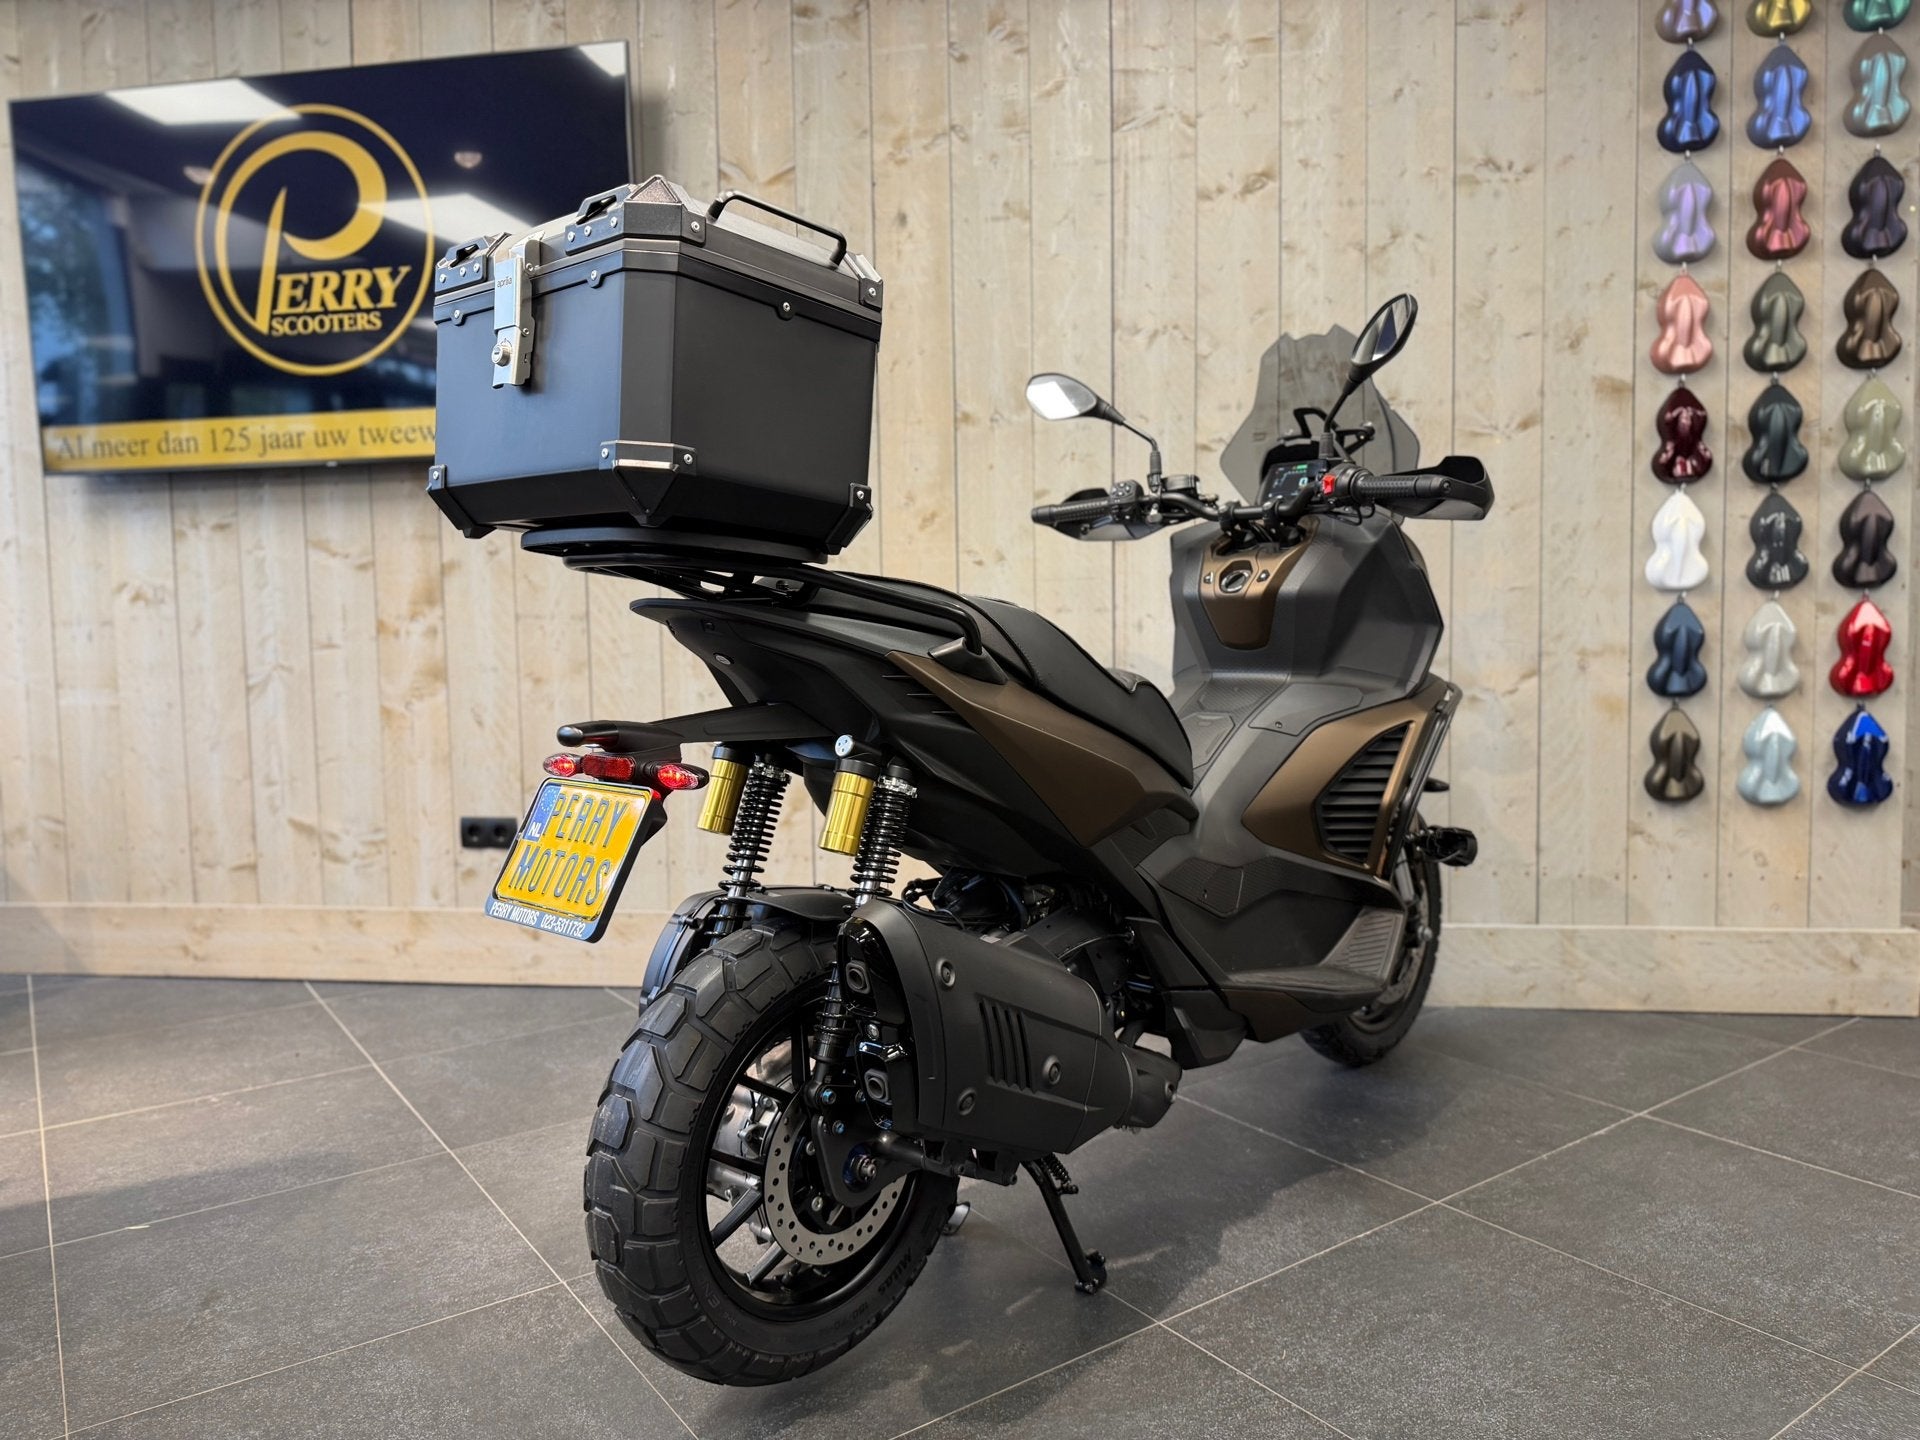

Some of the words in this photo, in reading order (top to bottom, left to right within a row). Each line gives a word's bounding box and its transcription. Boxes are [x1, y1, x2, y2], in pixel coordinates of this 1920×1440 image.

[271, 311, 383, 337] SCOOTERS
[58, 434, 84, 460] Al
[92, 437, 149, 459] meer
[156, 430, 200, 455] dan
[209, 426, 251, 454] 125
[258, 426, 305, 457] jaar
[313, 428, 349, 447] uw
[528, 822, 543, 838] NL
[542, 792, 629, 848] PERRY
[508, 845, 611, 905] MOTORS
[489, 901, 513, 919] PERRY
[509, 905, 540, 926] MOTORS
[540, 913, 587, 938] 023-5311732
